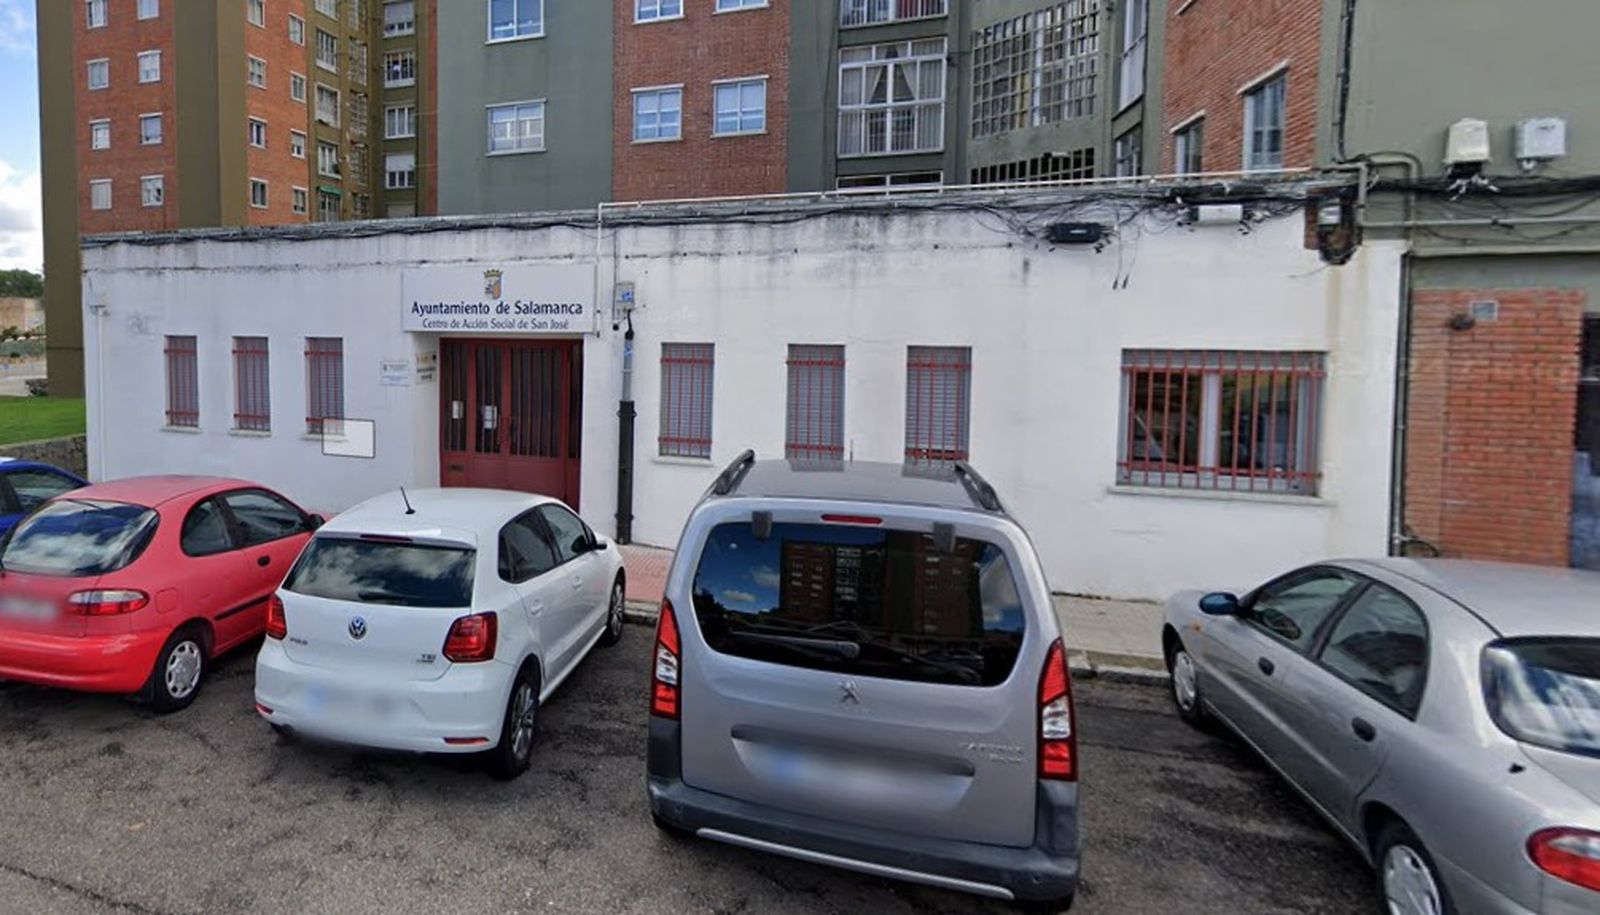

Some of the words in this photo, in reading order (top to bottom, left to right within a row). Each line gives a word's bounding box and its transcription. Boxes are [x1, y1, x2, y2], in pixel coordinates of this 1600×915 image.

[411, 301, 490, 317] Ayuntamiento
[495, 300, 510, 315] de
[514, 300, 583, 315] Salamanca
[422, 318, 449, 329] Centro
[451, 318, 461, 329] de
[463, 318, 488, 329] Acción
[491, 318, 515, 329] Social
[517, 318, 529, 329] de
[531, 318, 547, 330] San
[550, 319, 569, 330] José
